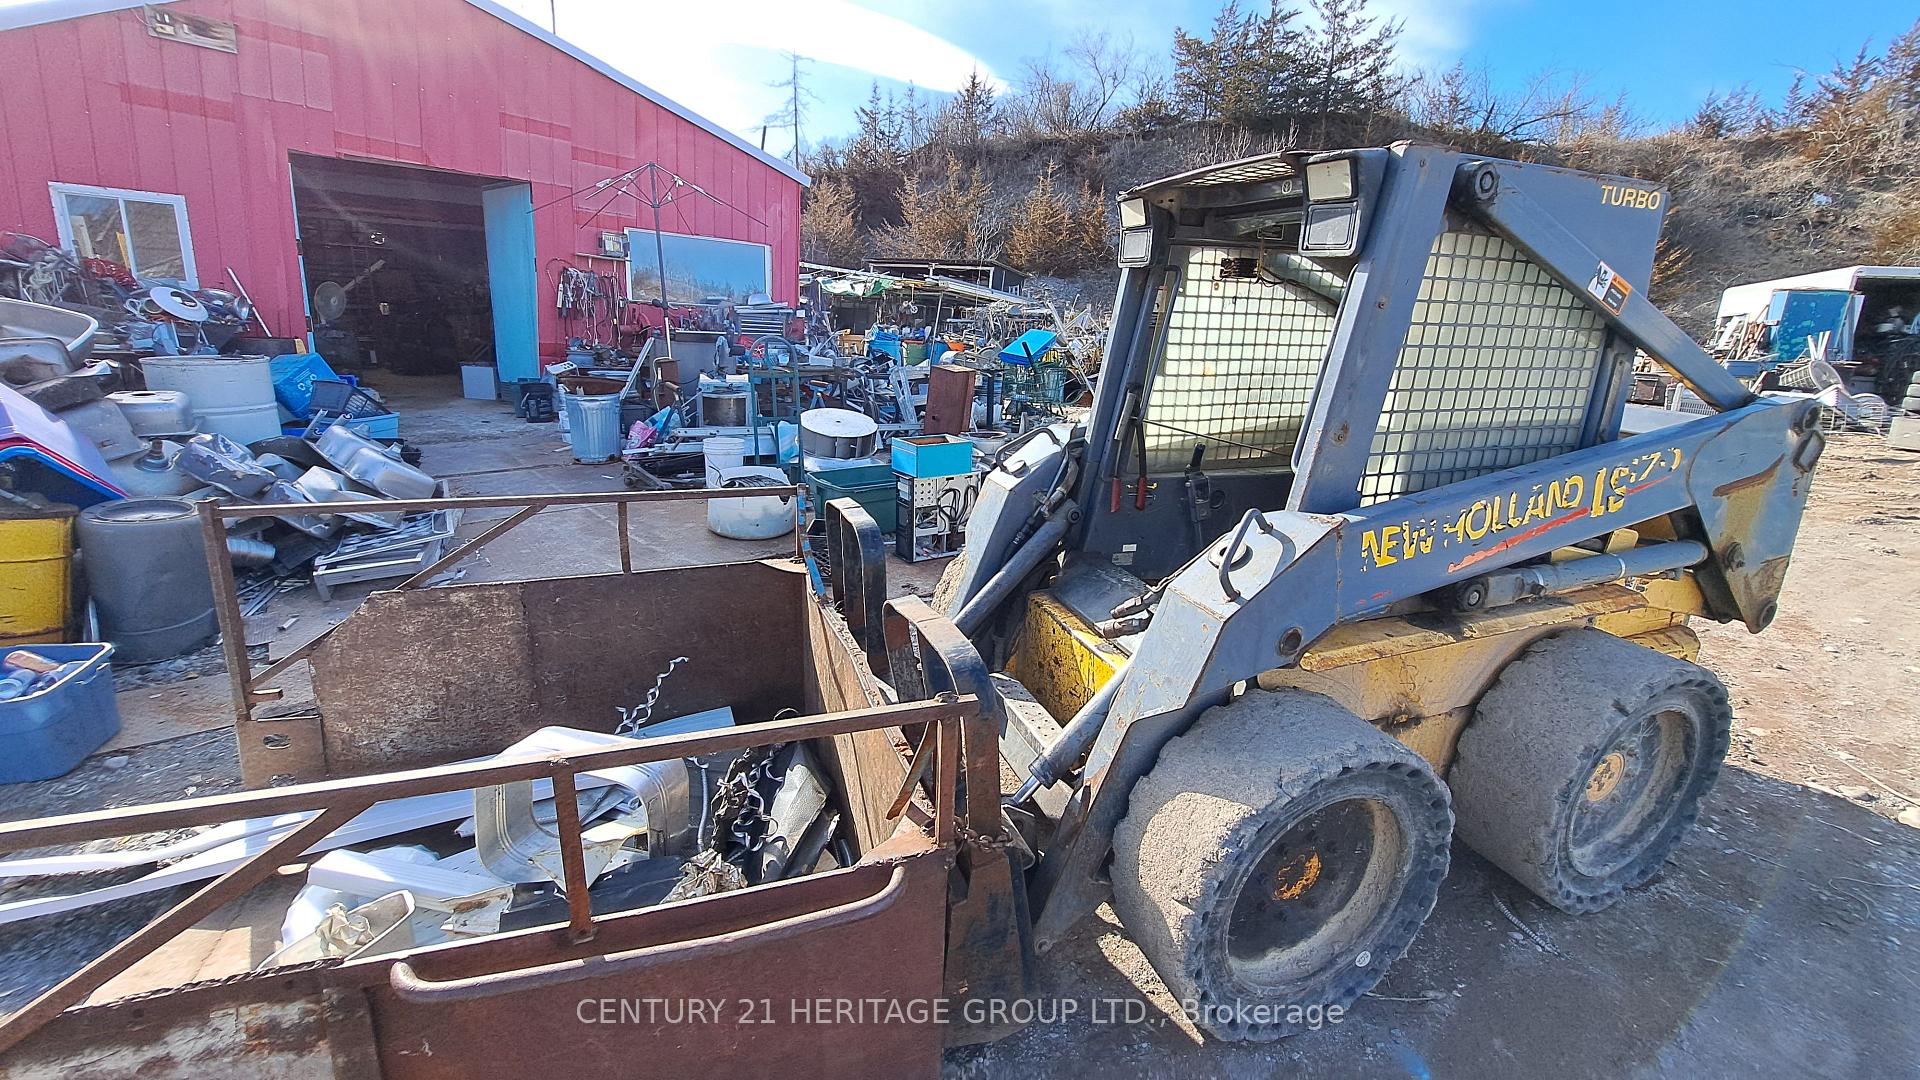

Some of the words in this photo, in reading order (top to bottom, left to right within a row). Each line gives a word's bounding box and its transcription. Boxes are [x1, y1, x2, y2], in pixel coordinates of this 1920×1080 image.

[1601, 184, 1661, 210] TURBO
[1360, 518, 1437, 572] NEW
[1443, 474, 1584, 546] HOLLAND
